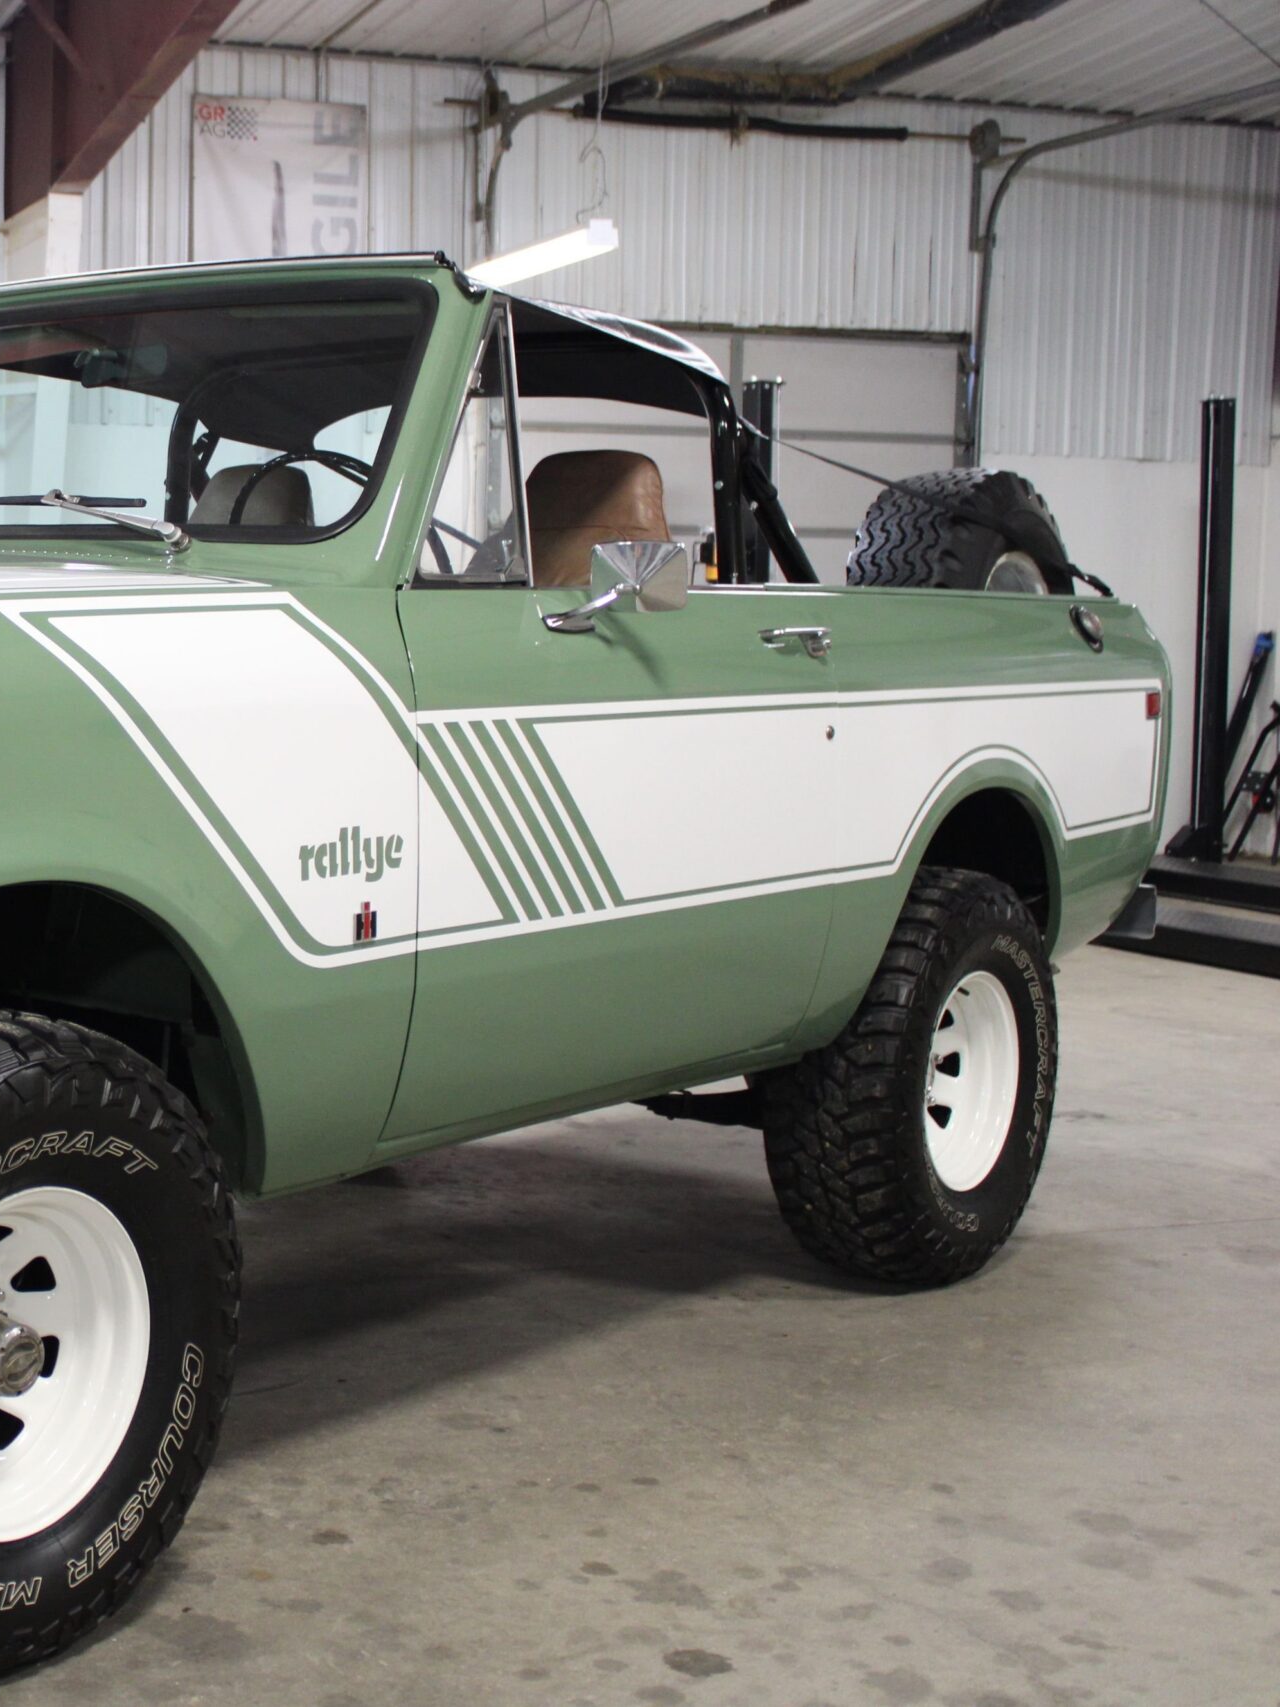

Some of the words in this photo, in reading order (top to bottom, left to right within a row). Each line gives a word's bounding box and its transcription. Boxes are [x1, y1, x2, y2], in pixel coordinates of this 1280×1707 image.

[198, 105, 225, 121] GR
[299, 826, 404, 882] rallye
[68, 1343, 205, 1587] COURSER
